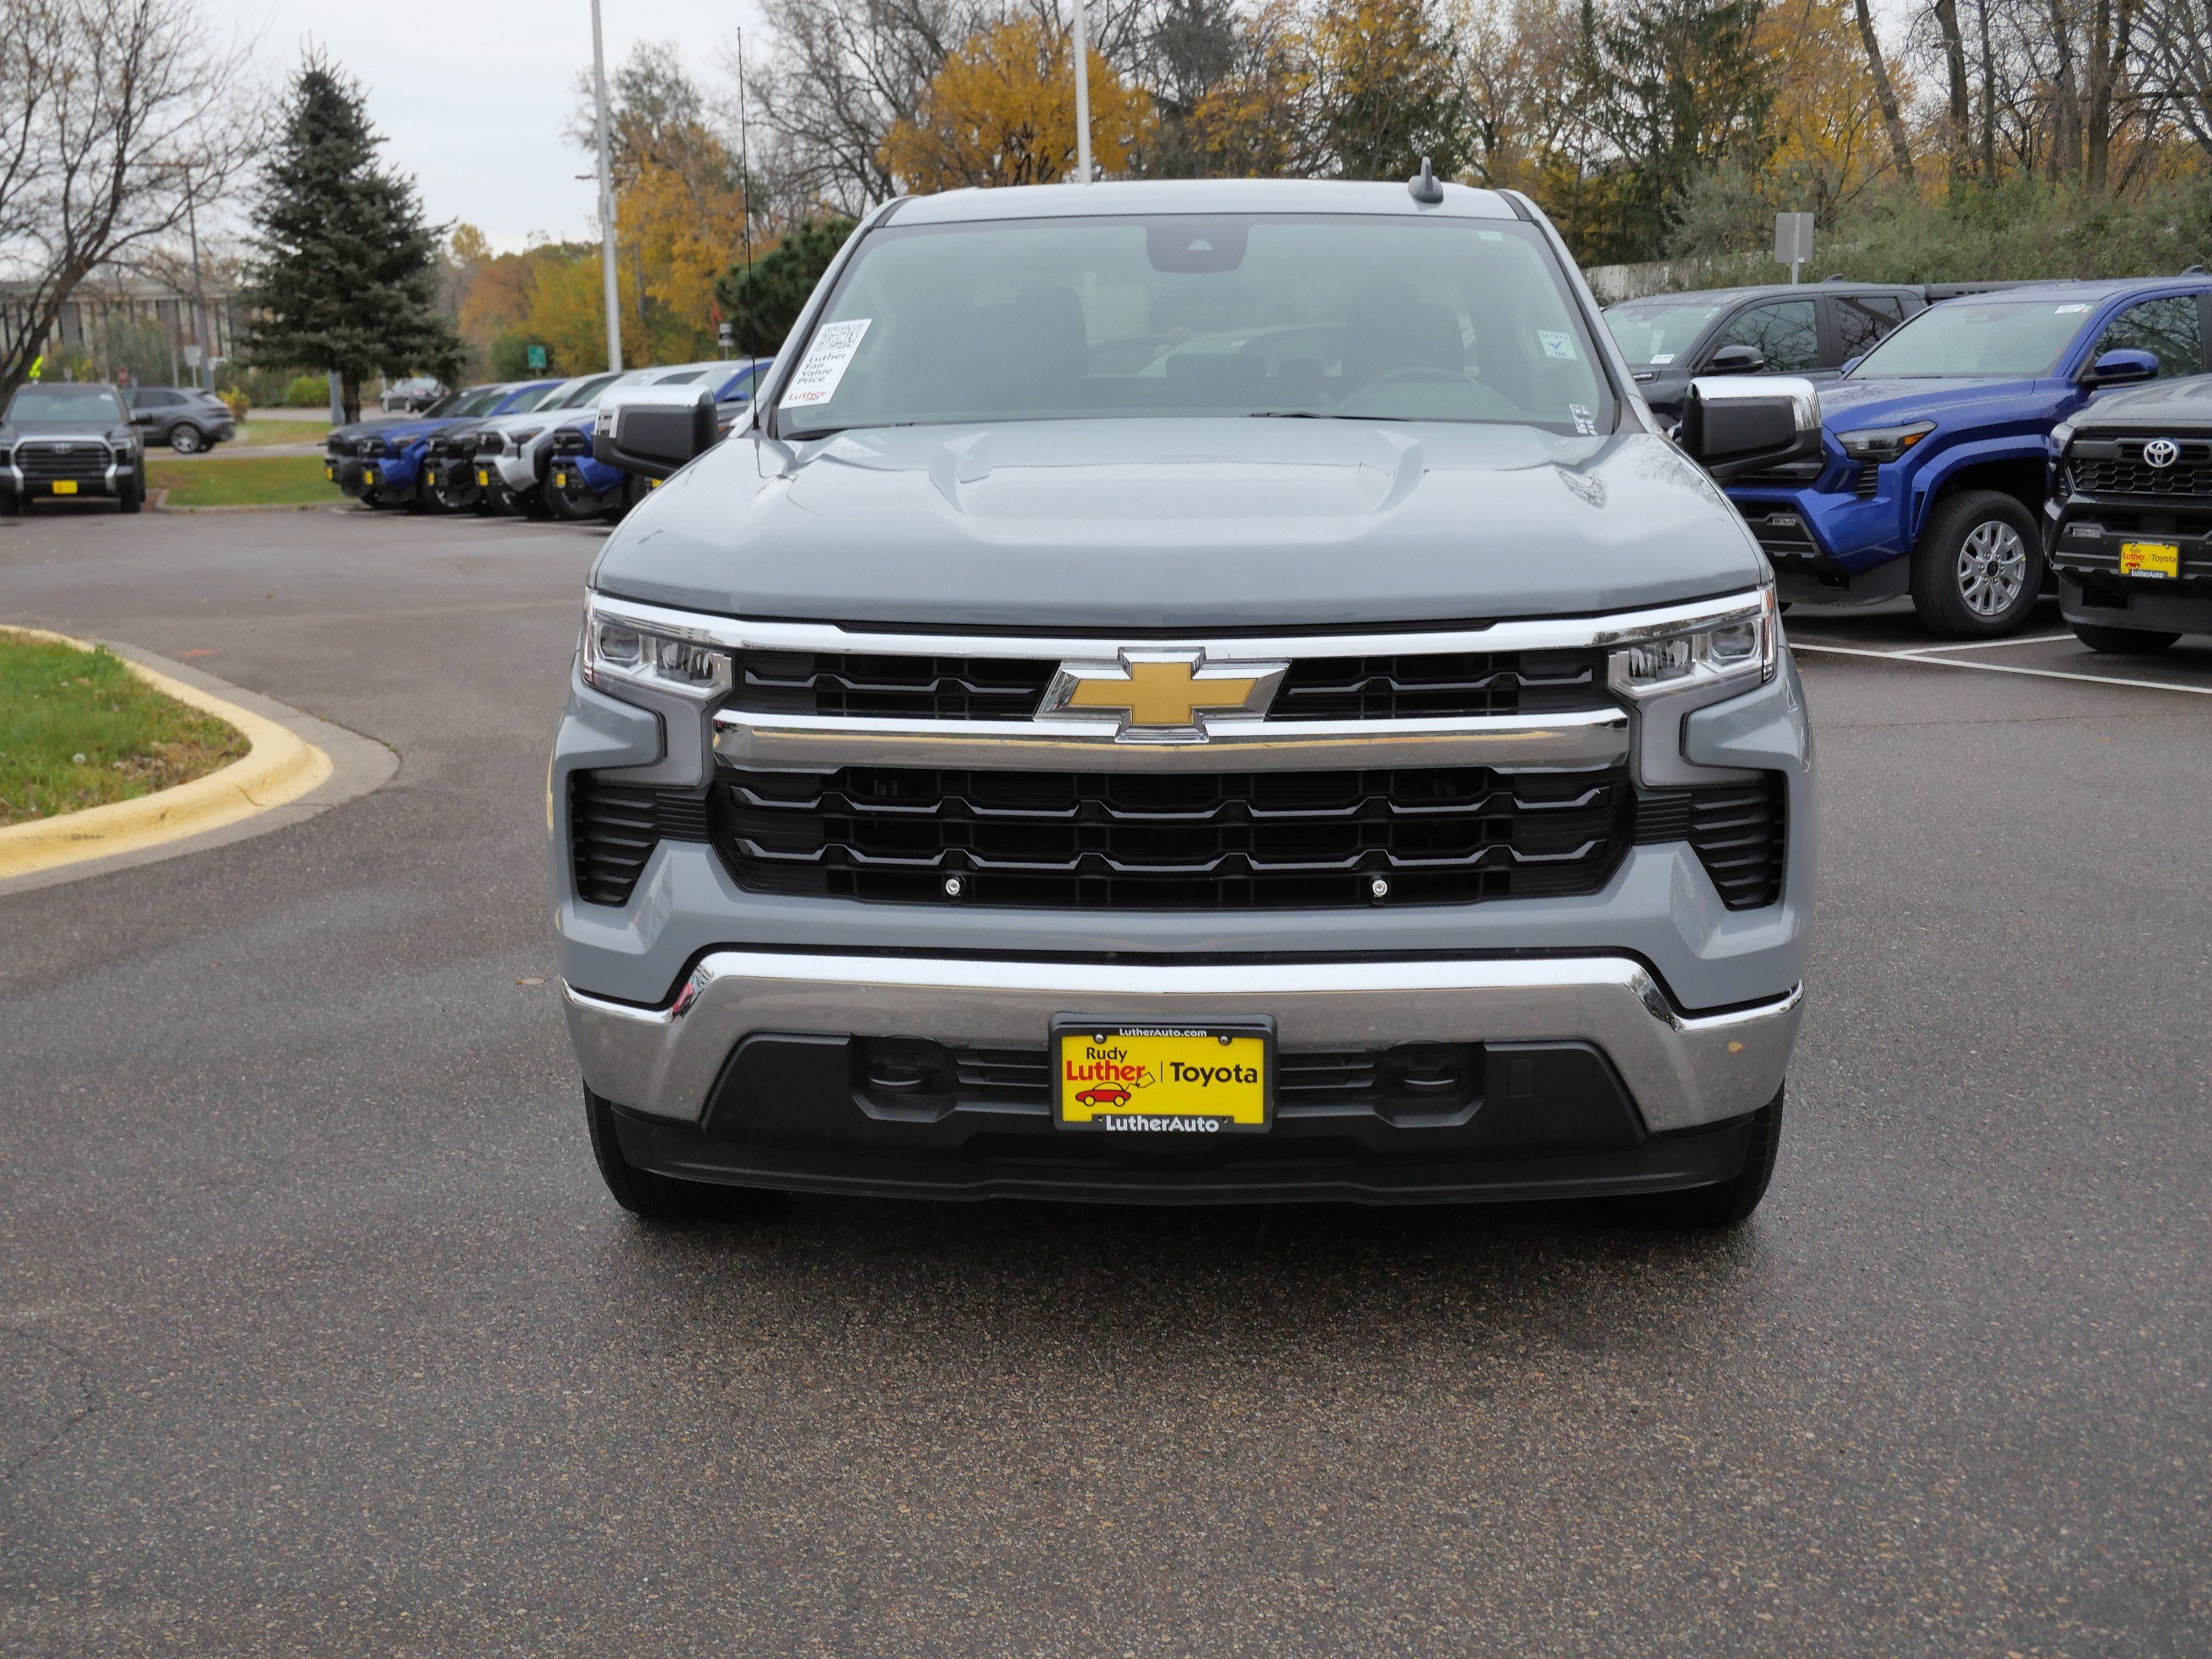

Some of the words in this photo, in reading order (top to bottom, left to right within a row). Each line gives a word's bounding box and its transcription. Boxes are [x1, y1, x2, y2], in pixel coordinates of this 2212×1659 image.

[808, 353, 846, 362] Luther
[802, 368, 833, 377] Value
[788, 391, 826, 400] Luther
[2123, 552, 2145, 561] Luther
[2151, 554, 2177, 563] Toyota
[2131, 569, 2164, 578] LutherAuto
[1119, 1028, 1207, 1037] LutherAuto.com
[1086, 1047, 1127, 1063] Rudy
[1066, 1060, 1146, 1081] Luther
[1170, 1062, 1258, 1087] Toyota
[1106, 1115, 1220, 1132] LutherAuto
